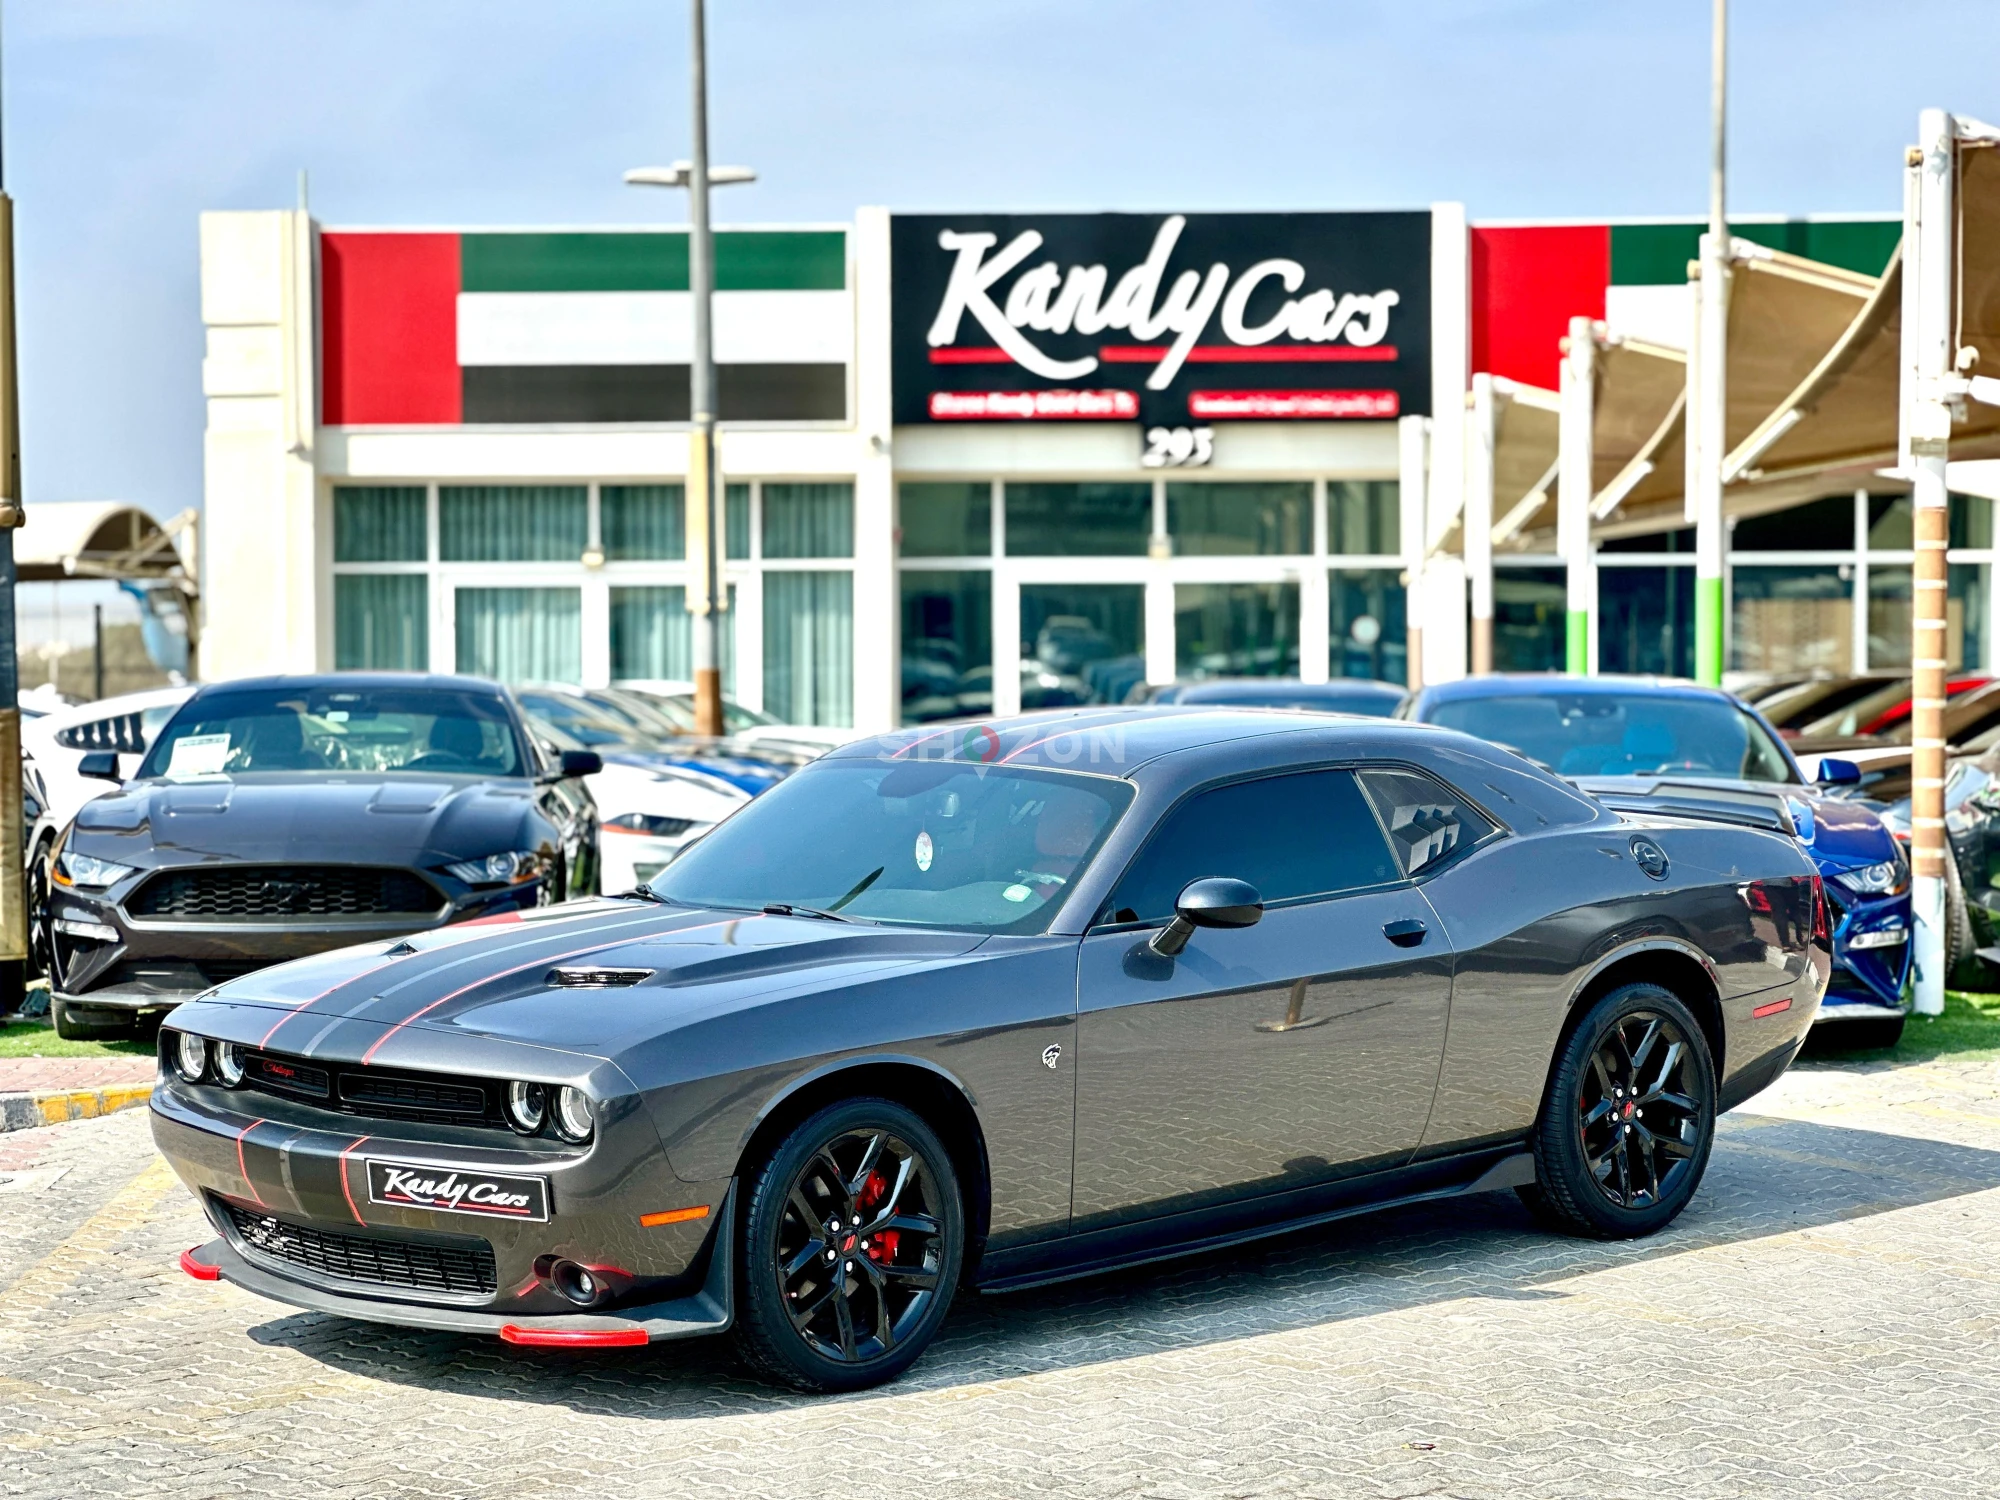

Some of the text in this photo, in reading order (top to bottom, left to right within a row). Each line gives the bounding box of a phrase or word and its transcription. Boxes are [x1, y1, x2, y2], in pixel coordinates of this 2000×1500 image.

[928, 214, 1400, 390] Kandy Cars
[384, 1168, 531, 1208] Kandy Cars
